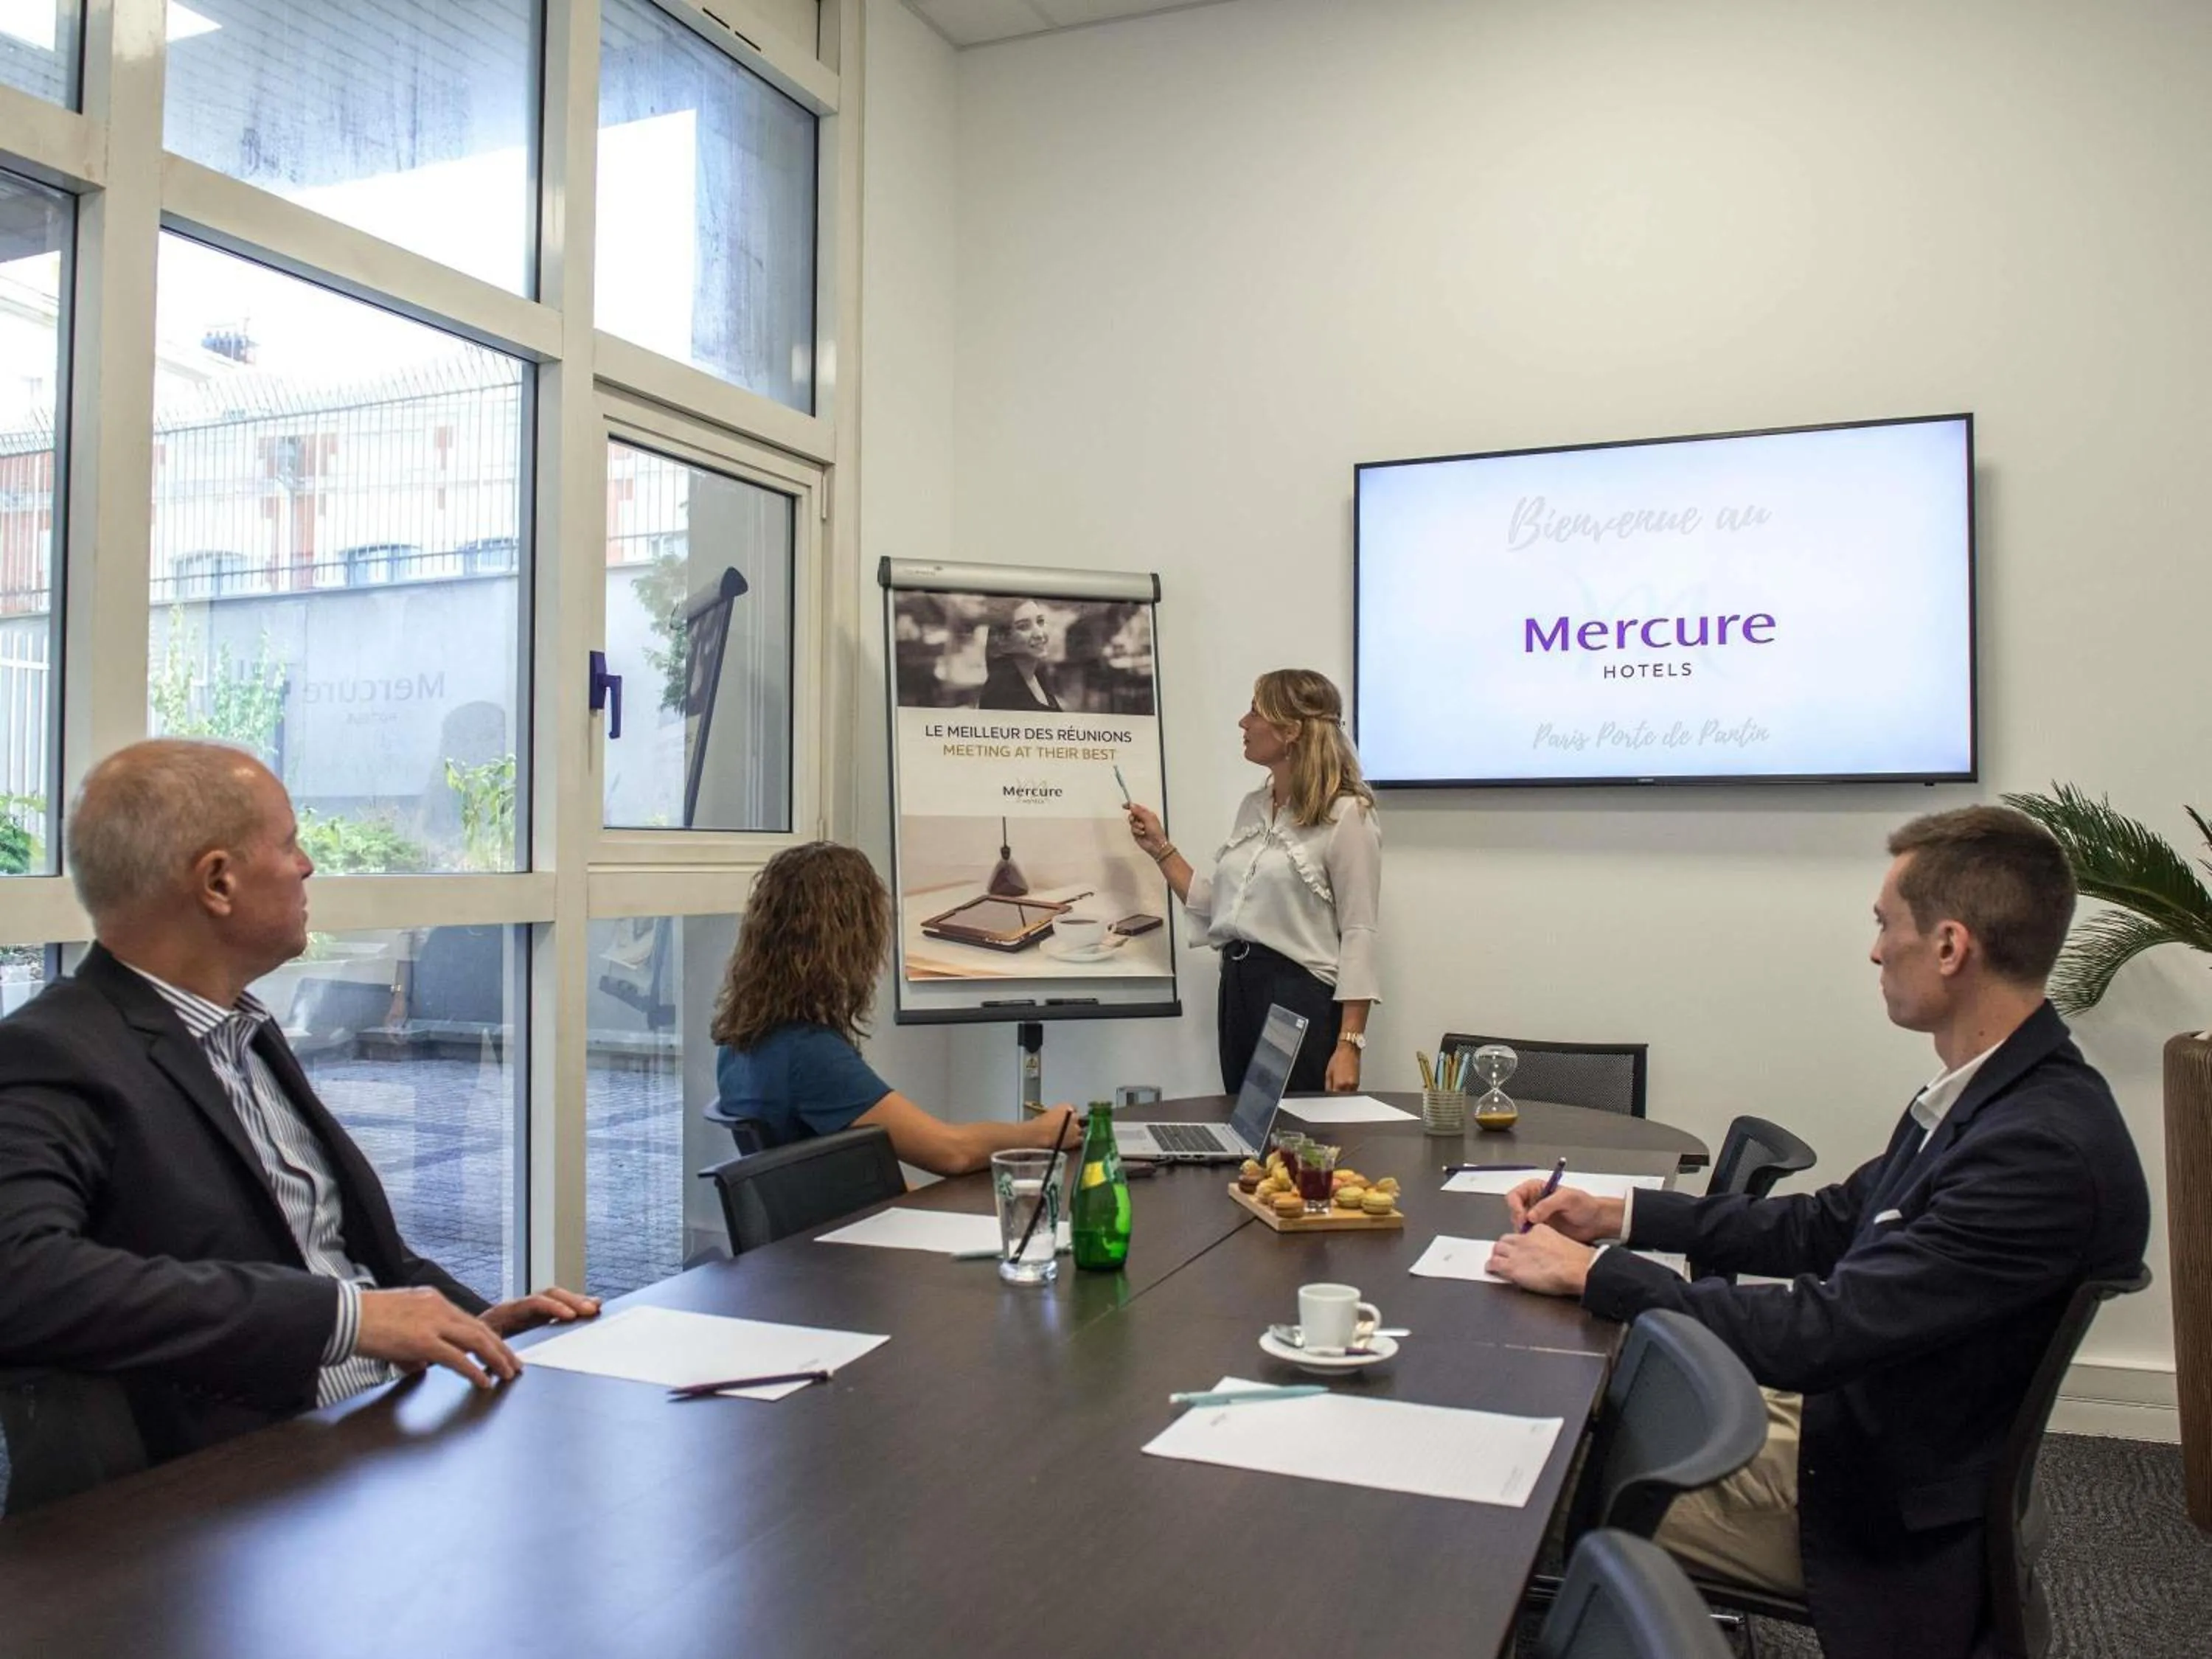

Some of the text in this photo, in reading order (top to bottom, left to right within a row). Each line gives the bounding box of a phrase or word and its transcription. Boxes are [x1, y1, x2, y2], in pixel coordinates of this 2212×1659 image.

[1506, 495, 1773, 552] Bienvenue au
[1525, 613, 1776, 653] Mercure
[1603, 662, 1693, 679] HOTELS
[925, 725, 1133, 743] LE MEILLEUR DES RÉUNIONS
[1532, 717, 1770, 751] Paris Porte de Pantin
[943, 744, 1117, 761] MEETING AT THEIR BEST
[1003, 785, 1063, 797] Mercure
